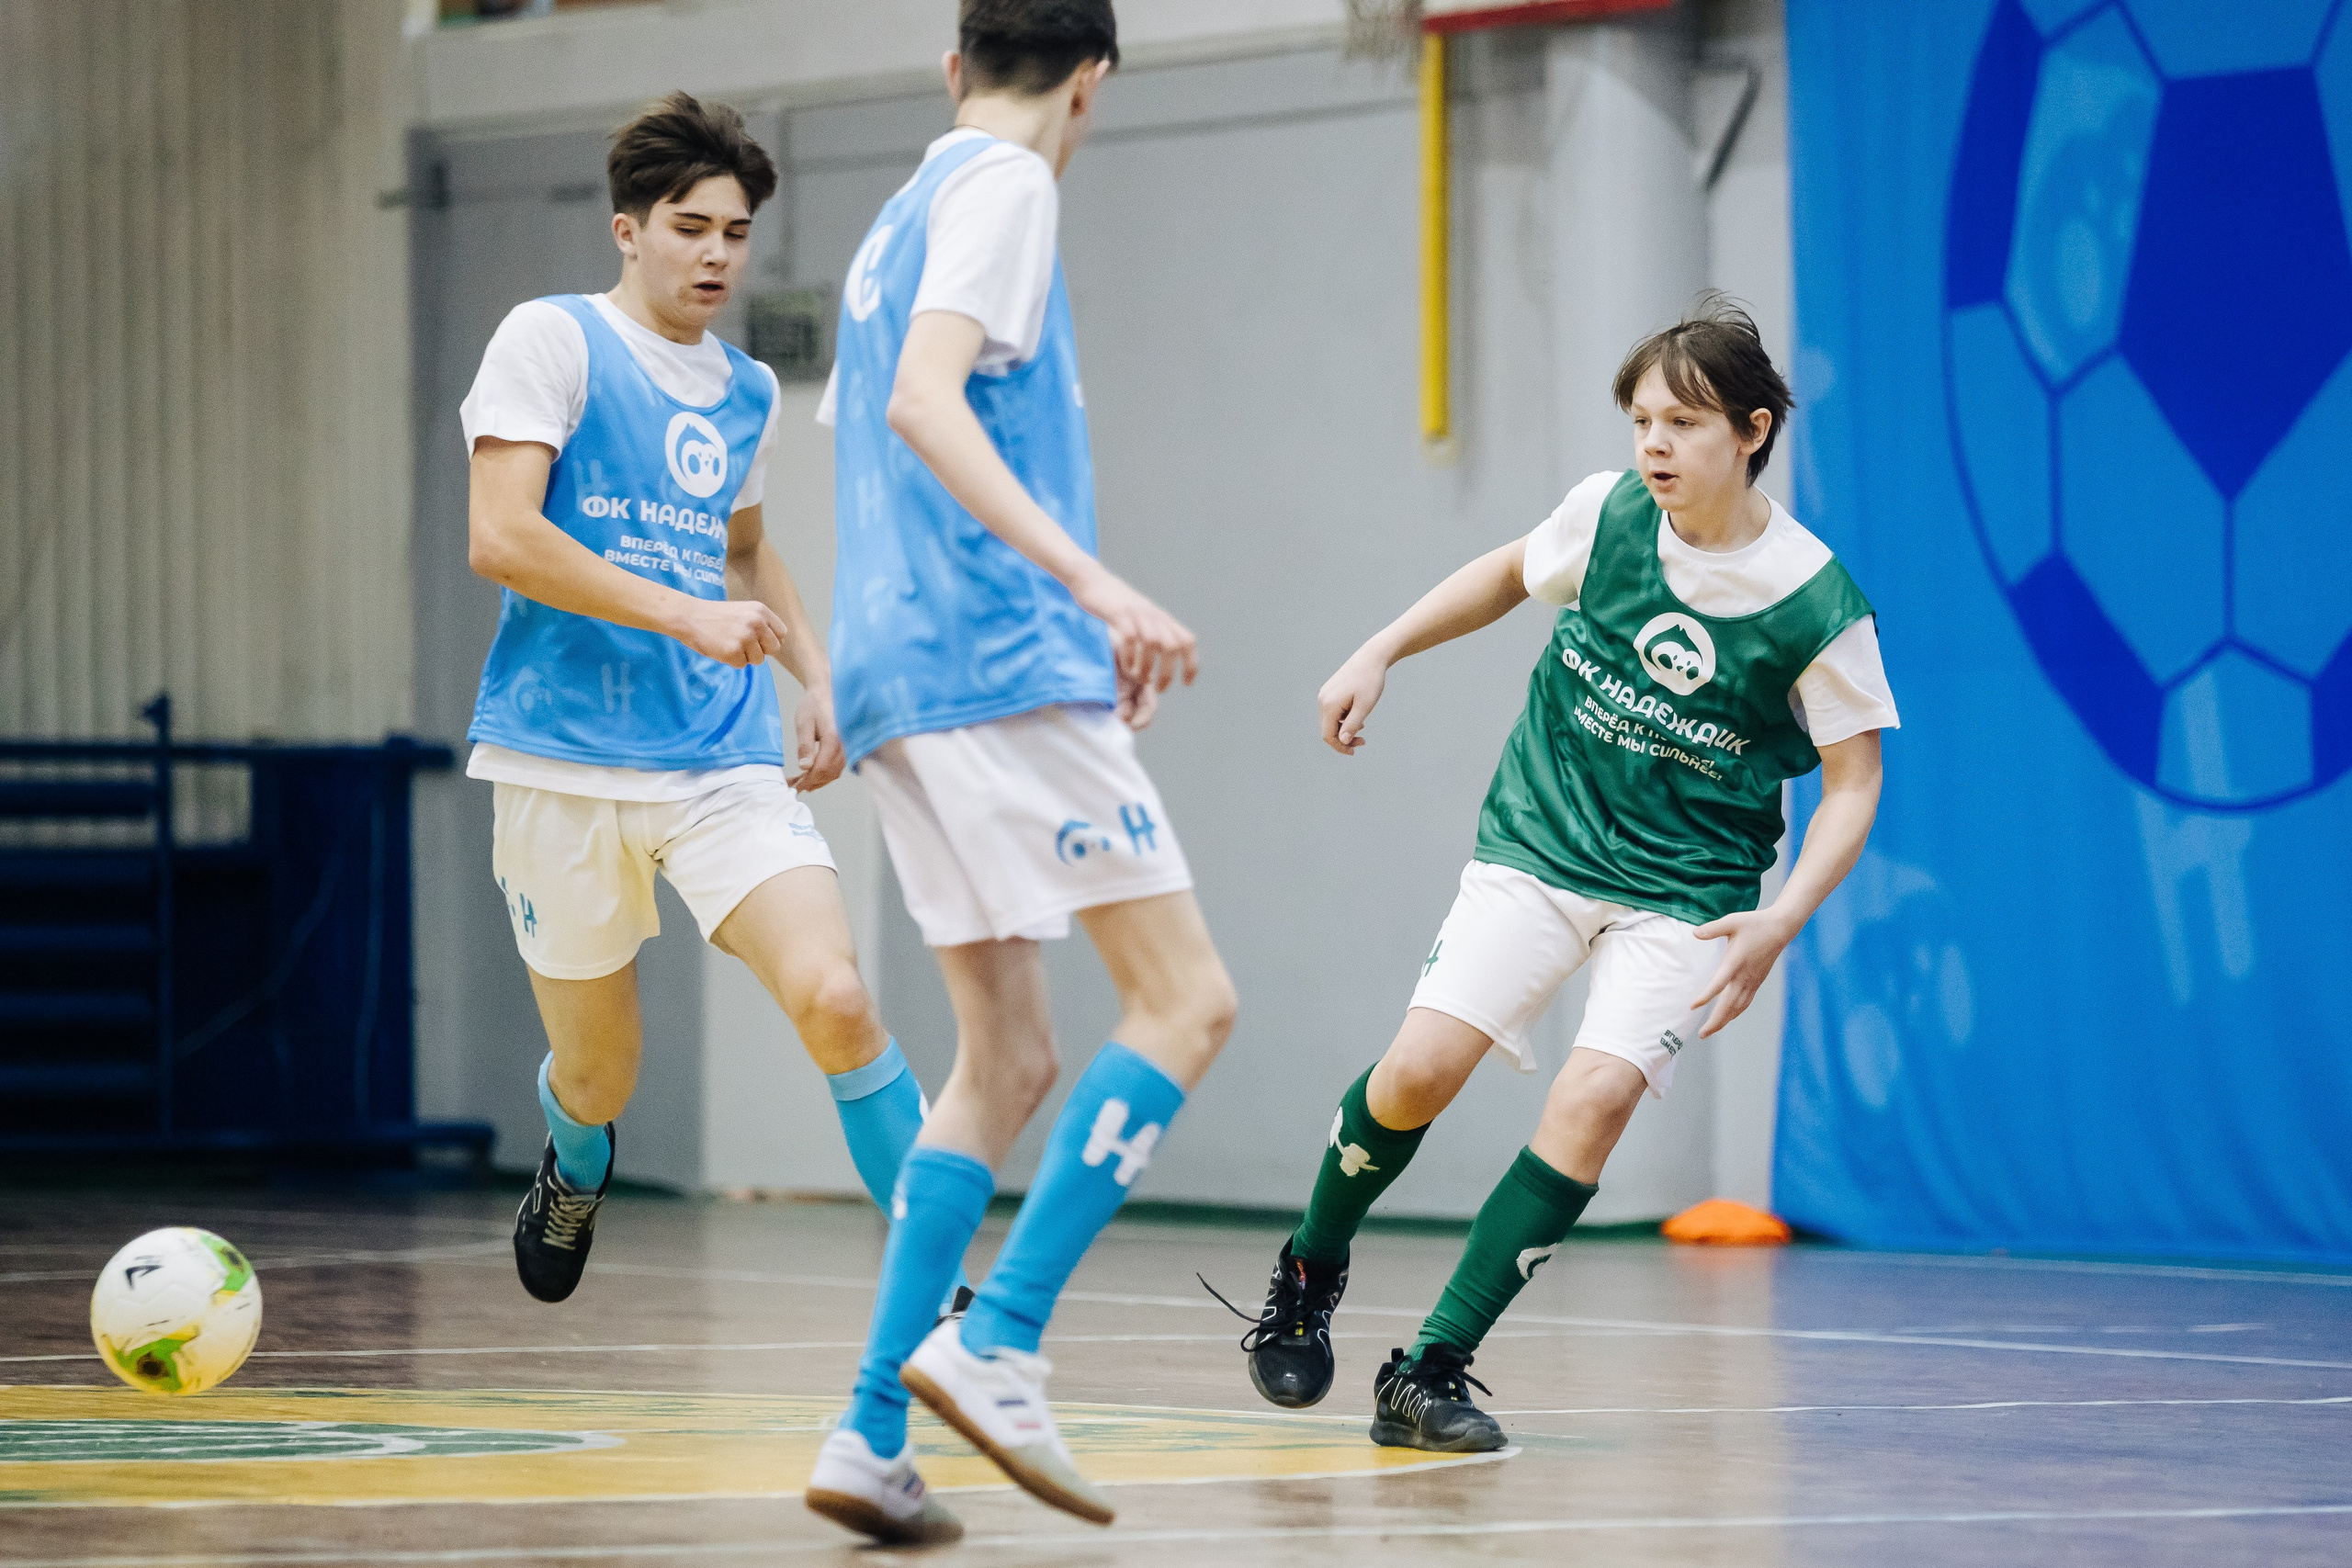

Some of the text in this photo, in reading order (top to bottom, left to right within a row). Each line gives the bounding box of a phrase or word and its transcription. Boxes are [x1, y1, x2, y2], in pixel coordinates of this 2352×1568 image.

[582, 496, 631, 520] ФК
[604, 549, 671, 572] ВМЕСТЕ
[682, 548, 691, 562] К
[1562, 648, 1601, 682] ФК
[1600, 673, 1751, 756] НАДЕЖДИК
[1584, 695, 1645, 736] ВПЕРЁД К
[1617, 735, 1645, 753] МЫ
